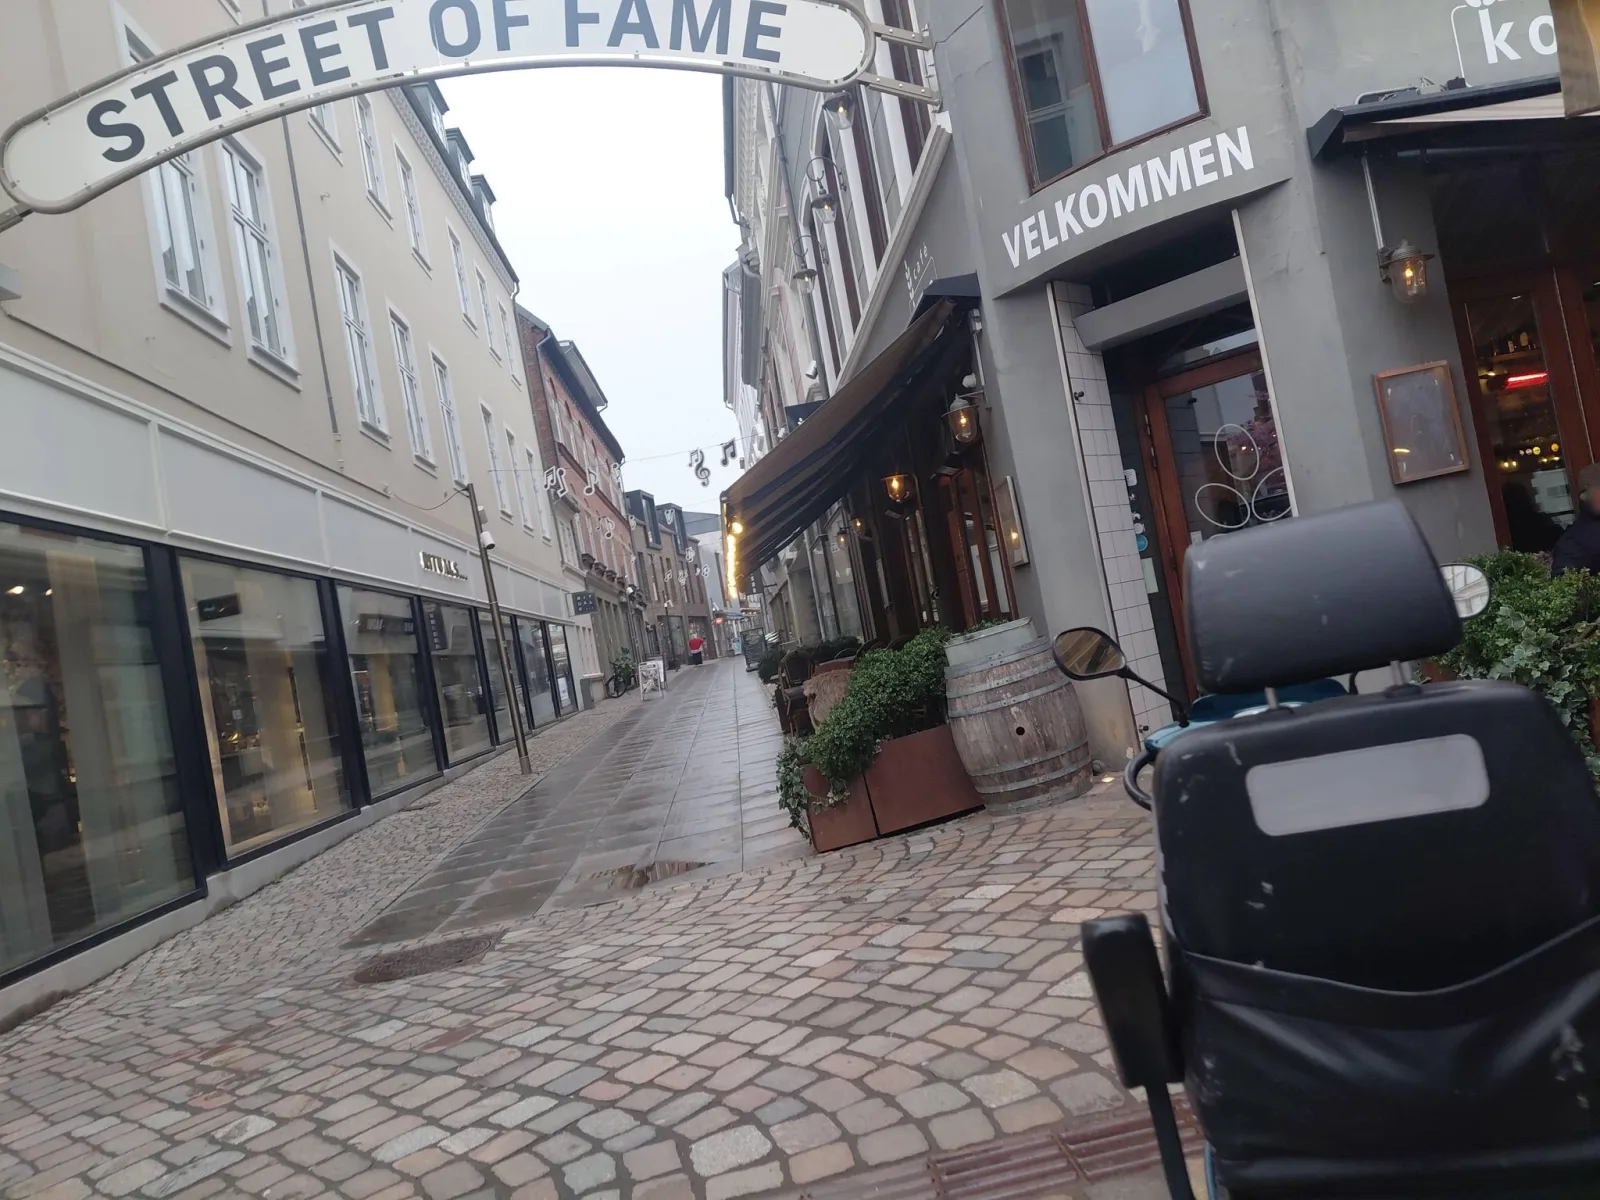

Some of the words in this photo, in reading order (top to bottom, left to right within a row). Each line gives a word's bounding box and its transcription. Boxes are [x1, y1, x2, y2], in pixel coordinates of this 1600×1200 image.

[86, 6, 395, 164] STREET
[428, 0, 530, 57] OF
[565, 0, 788, 63] FAME
[1001, 125, 1254, 268] VELKOMMEN
